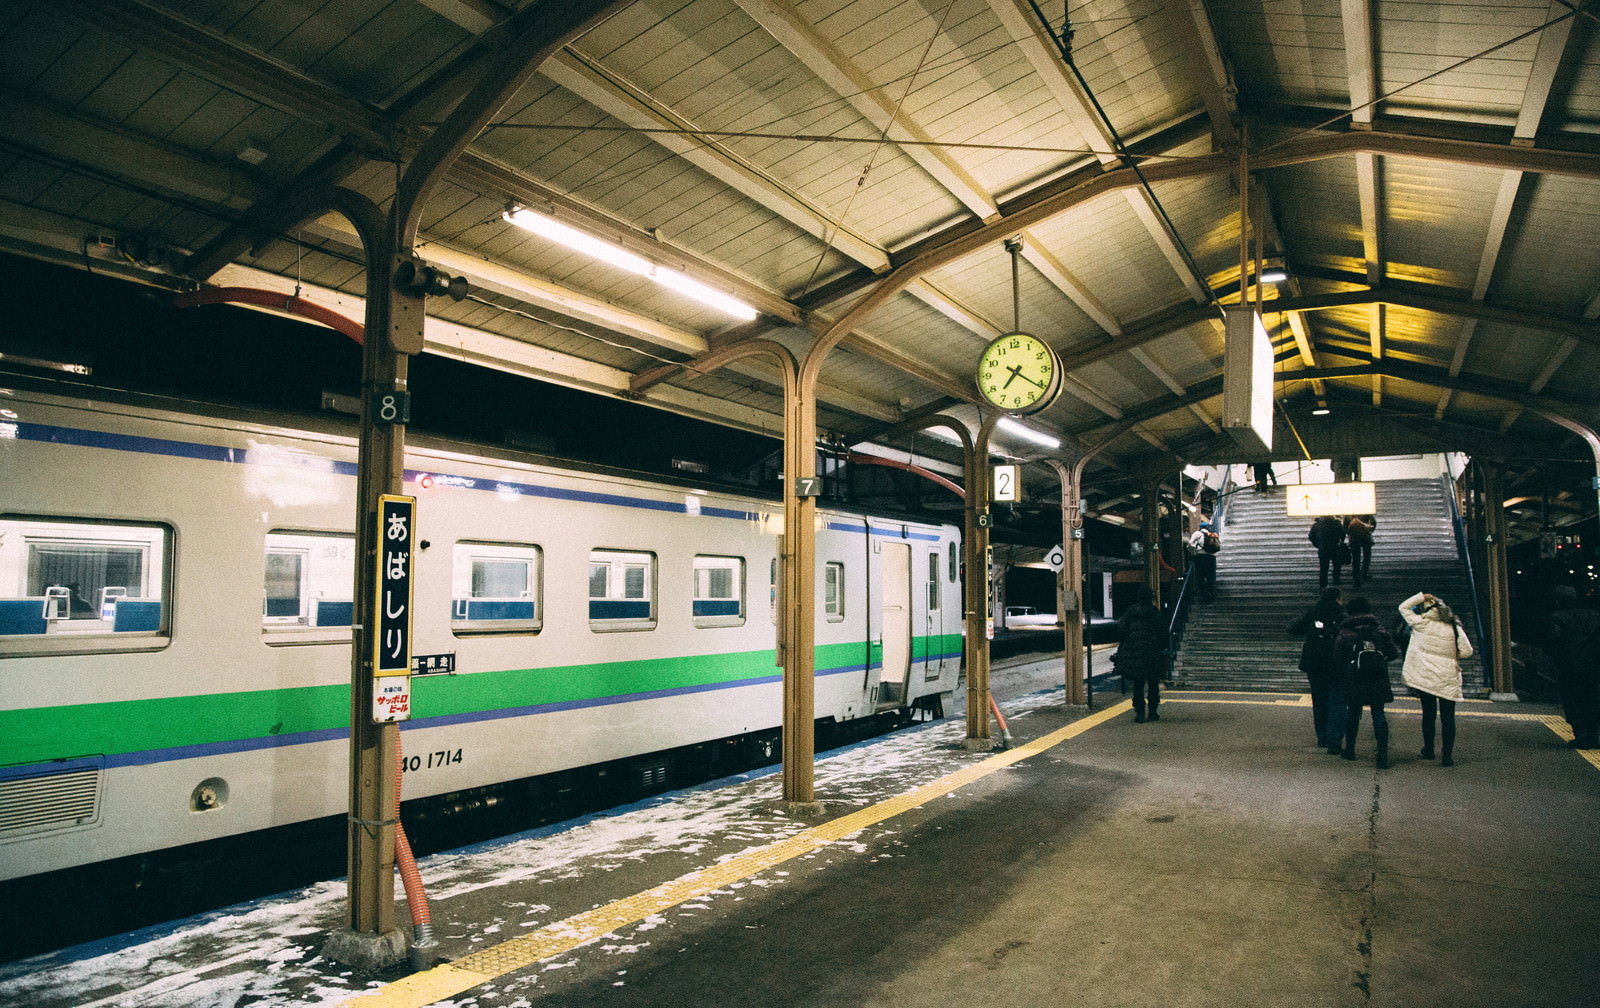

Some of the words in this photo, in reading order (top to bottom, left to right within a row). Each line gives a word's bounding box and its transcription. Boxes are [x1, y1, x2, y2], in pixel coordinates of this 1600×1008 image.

[1009, 341, 1020, 349] 12
[997, 348, 1006, 356] 11
[1036, 352, 1044, 360] 2
[989, 360, 999, 368] 10
[1040, 365, 1048, 373] 3
[985, 372, 992, 380] 9
[990, 385, 997, 393] 8
[1000, 394, 1007, 403] 7
[1027, 391, 1035, 400] 5
[1014, 396, 1021, 405] 6
[380, 395, 397, 421] 8
[801, 479, 814, 495] 7
[999, 472, 1010, 495] 2
[978, 514, 987, 527] 6
[1074, 529, 1082, 538] 5
[386, 512, 408, 660] あばしり
[377, 694, 408, 705] サッポロ
[389, 704, 408, 713] ビール
[402, 755, 421, 773] 40
[427, 748, 463, 768] 1714
